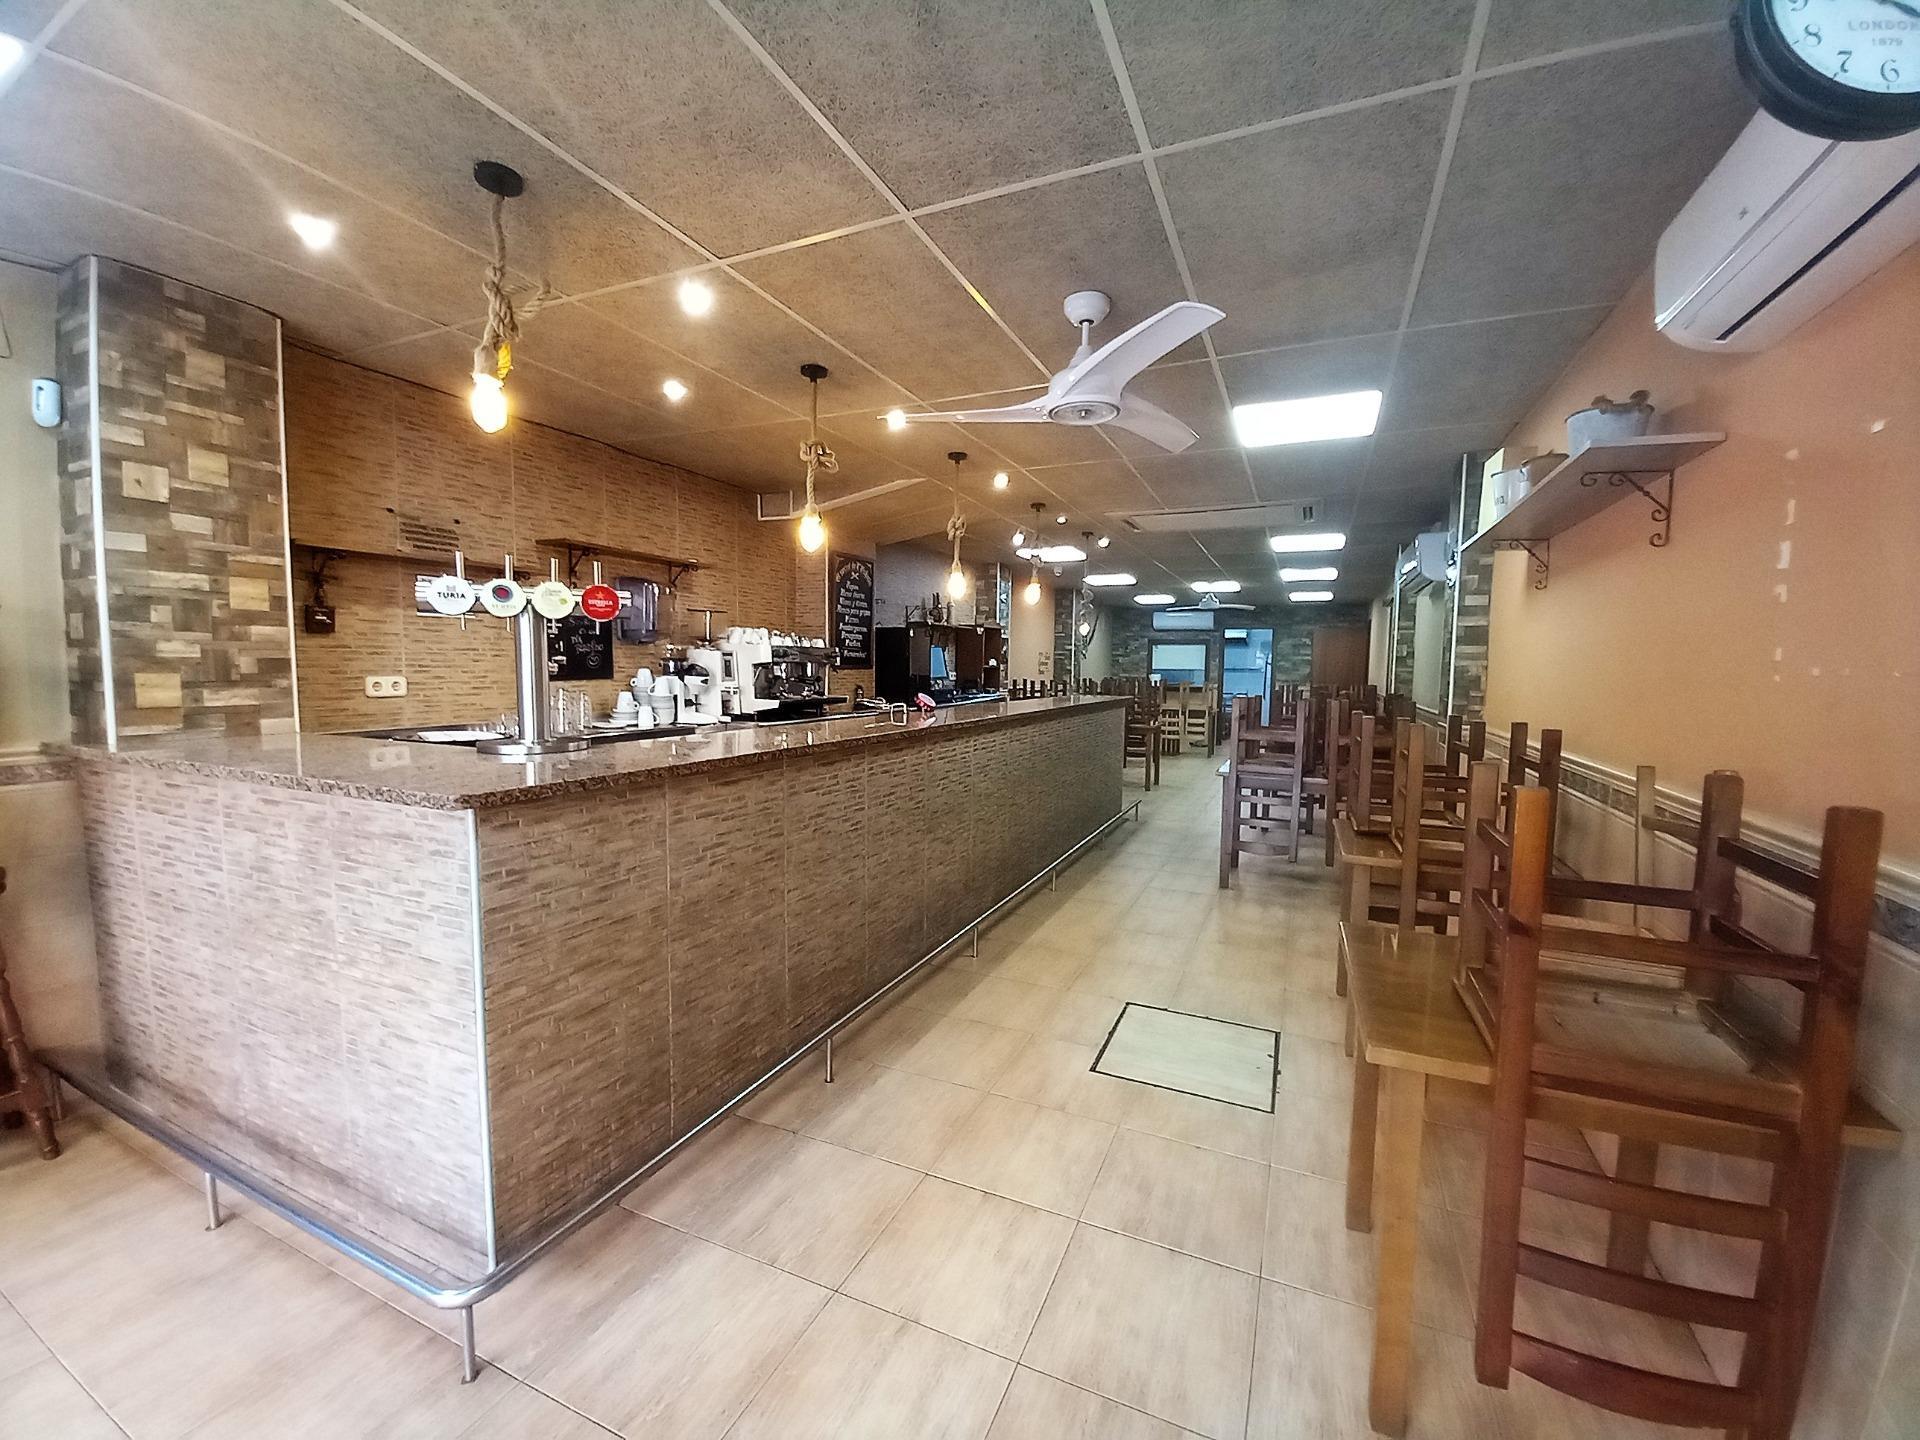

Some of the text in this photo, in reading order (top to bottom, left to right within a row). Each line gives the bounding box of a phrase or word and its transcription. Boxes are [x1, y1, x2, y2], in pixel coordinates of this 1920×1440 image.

[1803, 23, 1822, 47] 8
[1848, 20, 1920, 31] LONDON
[1837, 50, 1853, 74] 7
[1880, 59, 1900, 83] 6
[437, 591, 467, 599] TURIA
